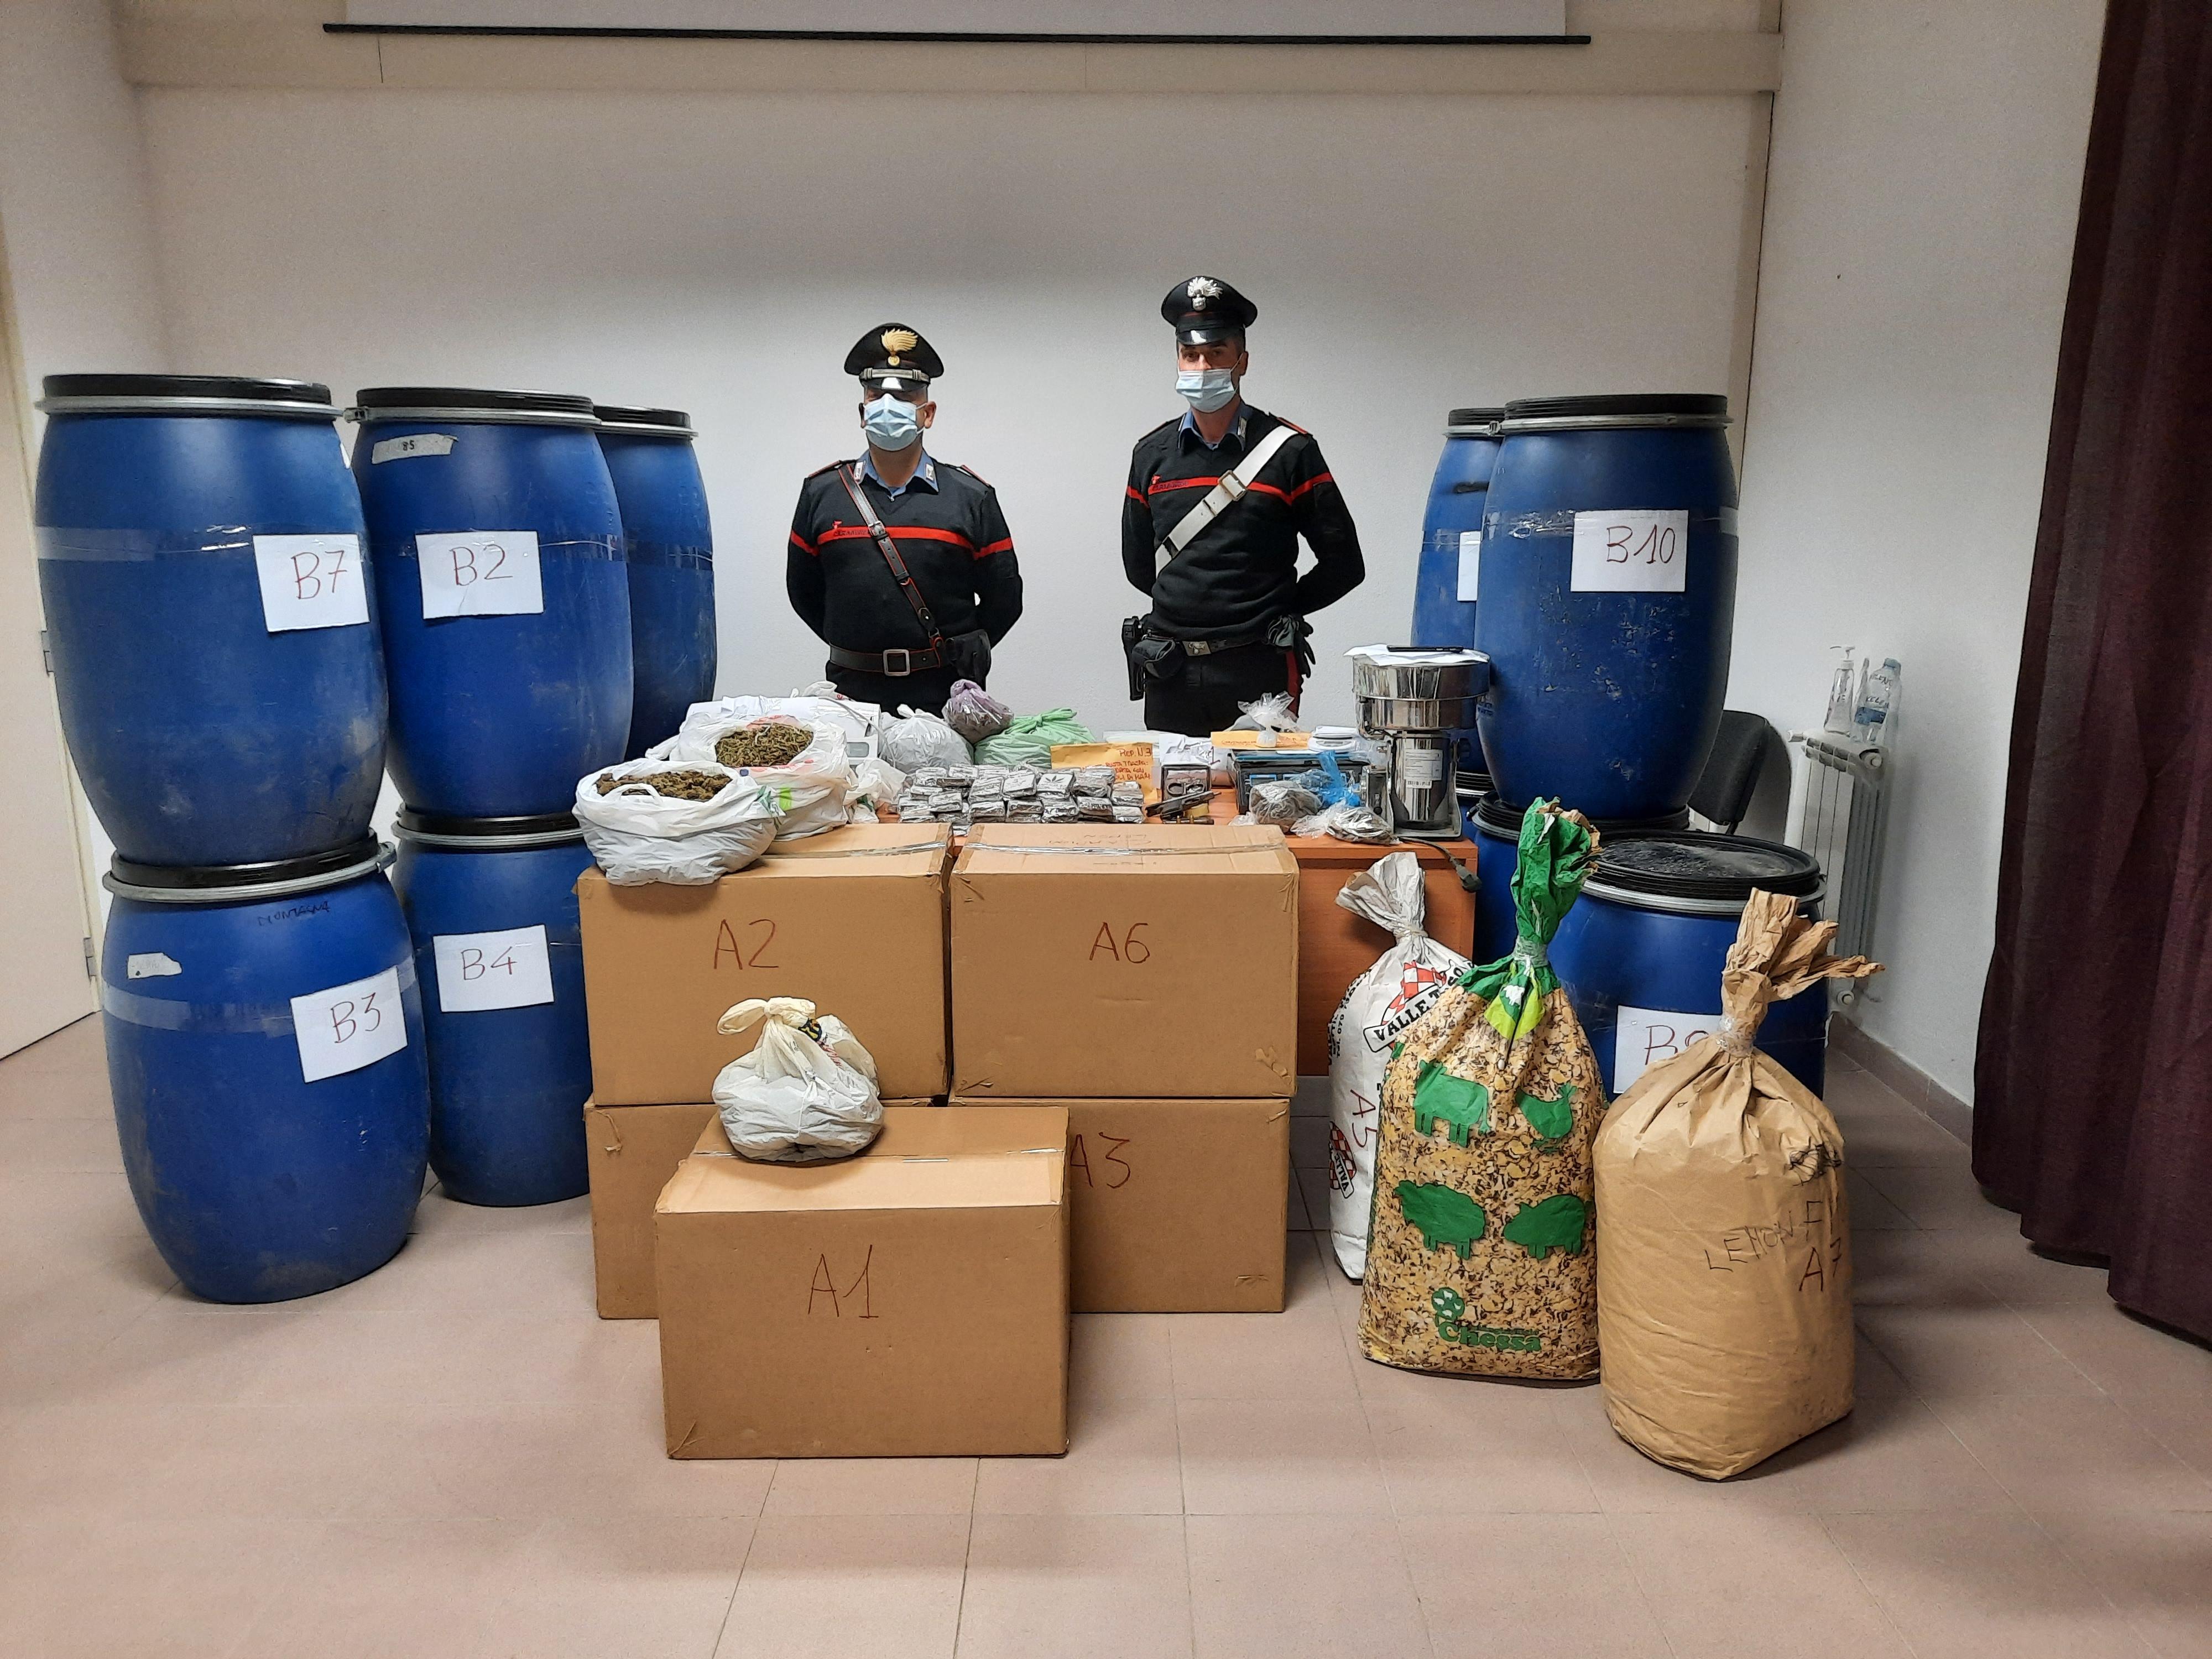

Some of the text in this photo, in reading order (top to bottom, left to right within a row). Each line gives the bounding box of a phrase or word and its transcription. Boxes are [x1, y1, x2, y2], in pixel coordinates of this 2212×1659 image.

[449, 544, 513, 586] B2
[1606, 524, 1676, 564] B10
[290, 550, 347, 599] B7
[461, 946, 518, 980] B4
[713, 919, 779, 970] A2
[1089, 922, 1150, 964] A6
[330, 992, 380, 1044] B3
[1374, 1000, 1430, 1041] VALLE
[1350, 1089, 1378, 1148] A5
[1070, 1131, 1131, 1189] A3
[807, 1244, 879, 1318] A1
[1799, 1237, 1842, 1292] A7
[1438, 1321, 1542, 1352] Chessa
